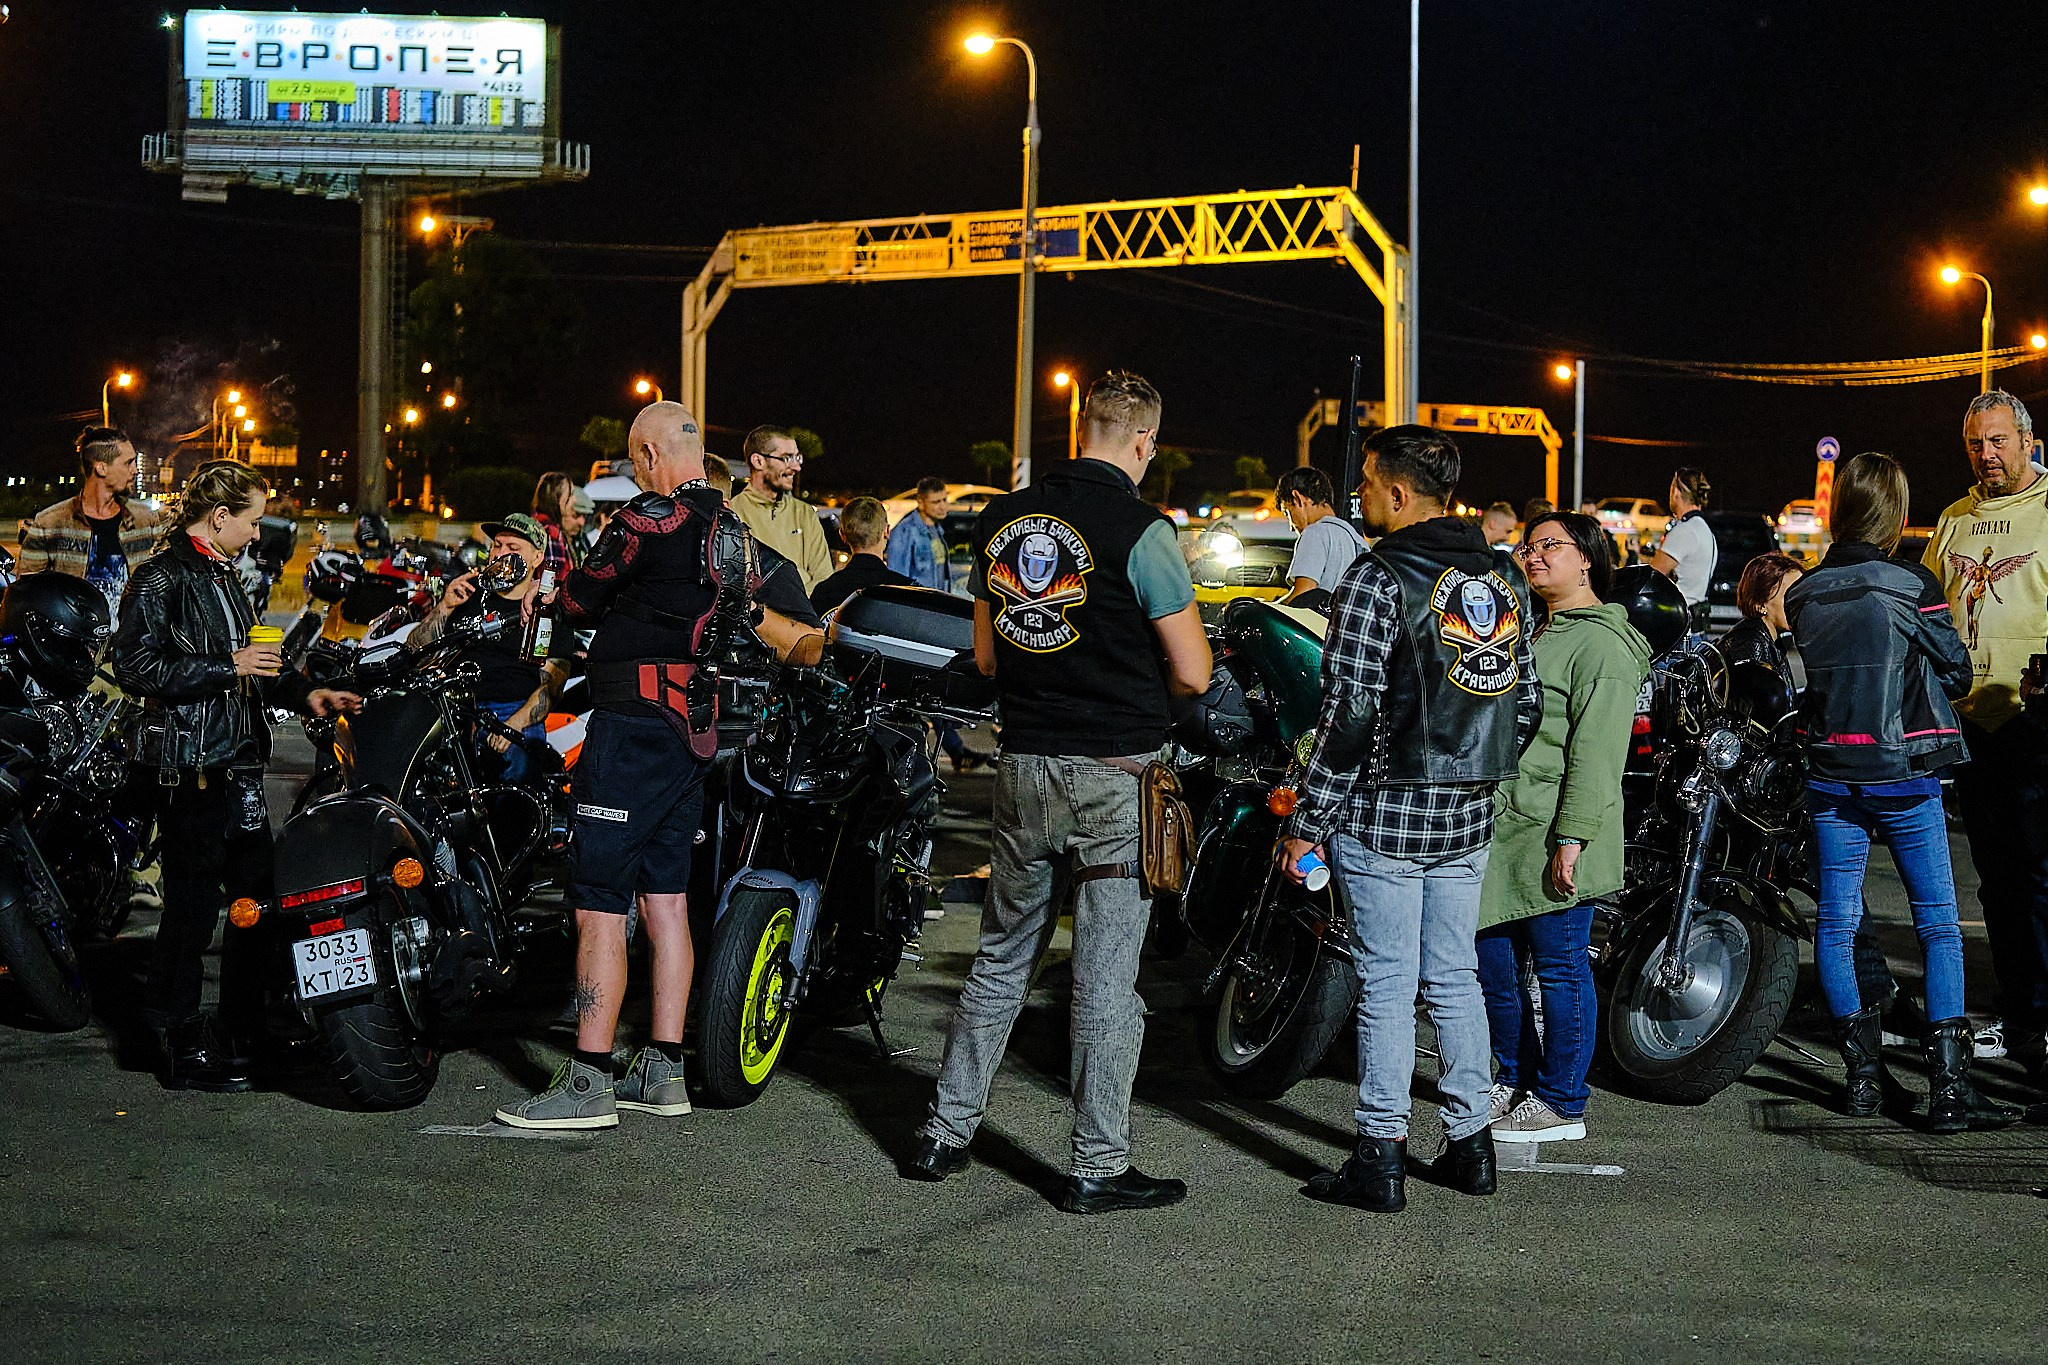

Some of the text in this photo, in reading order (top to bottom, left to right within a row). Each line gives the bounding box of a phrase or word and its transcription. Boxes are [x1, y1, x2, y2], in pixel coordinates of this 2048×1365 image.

[989, 518, 1048, 557] ВЕЖЛИВЫЕ
[1969, 520, 2011, 536] NIRVANA
[997, 614, 1071, 648] КРАСНОДАР
[1023, 613, 1043, 628] 123
[1452, 661, 1518, 691] КРАСНОДАР
[1478, 655, 1498, 670] 123
[304, 934, 359, 962] 3033
[334, 957, 353, 966] RUS
[303, 963, 369, 995] KT 23
